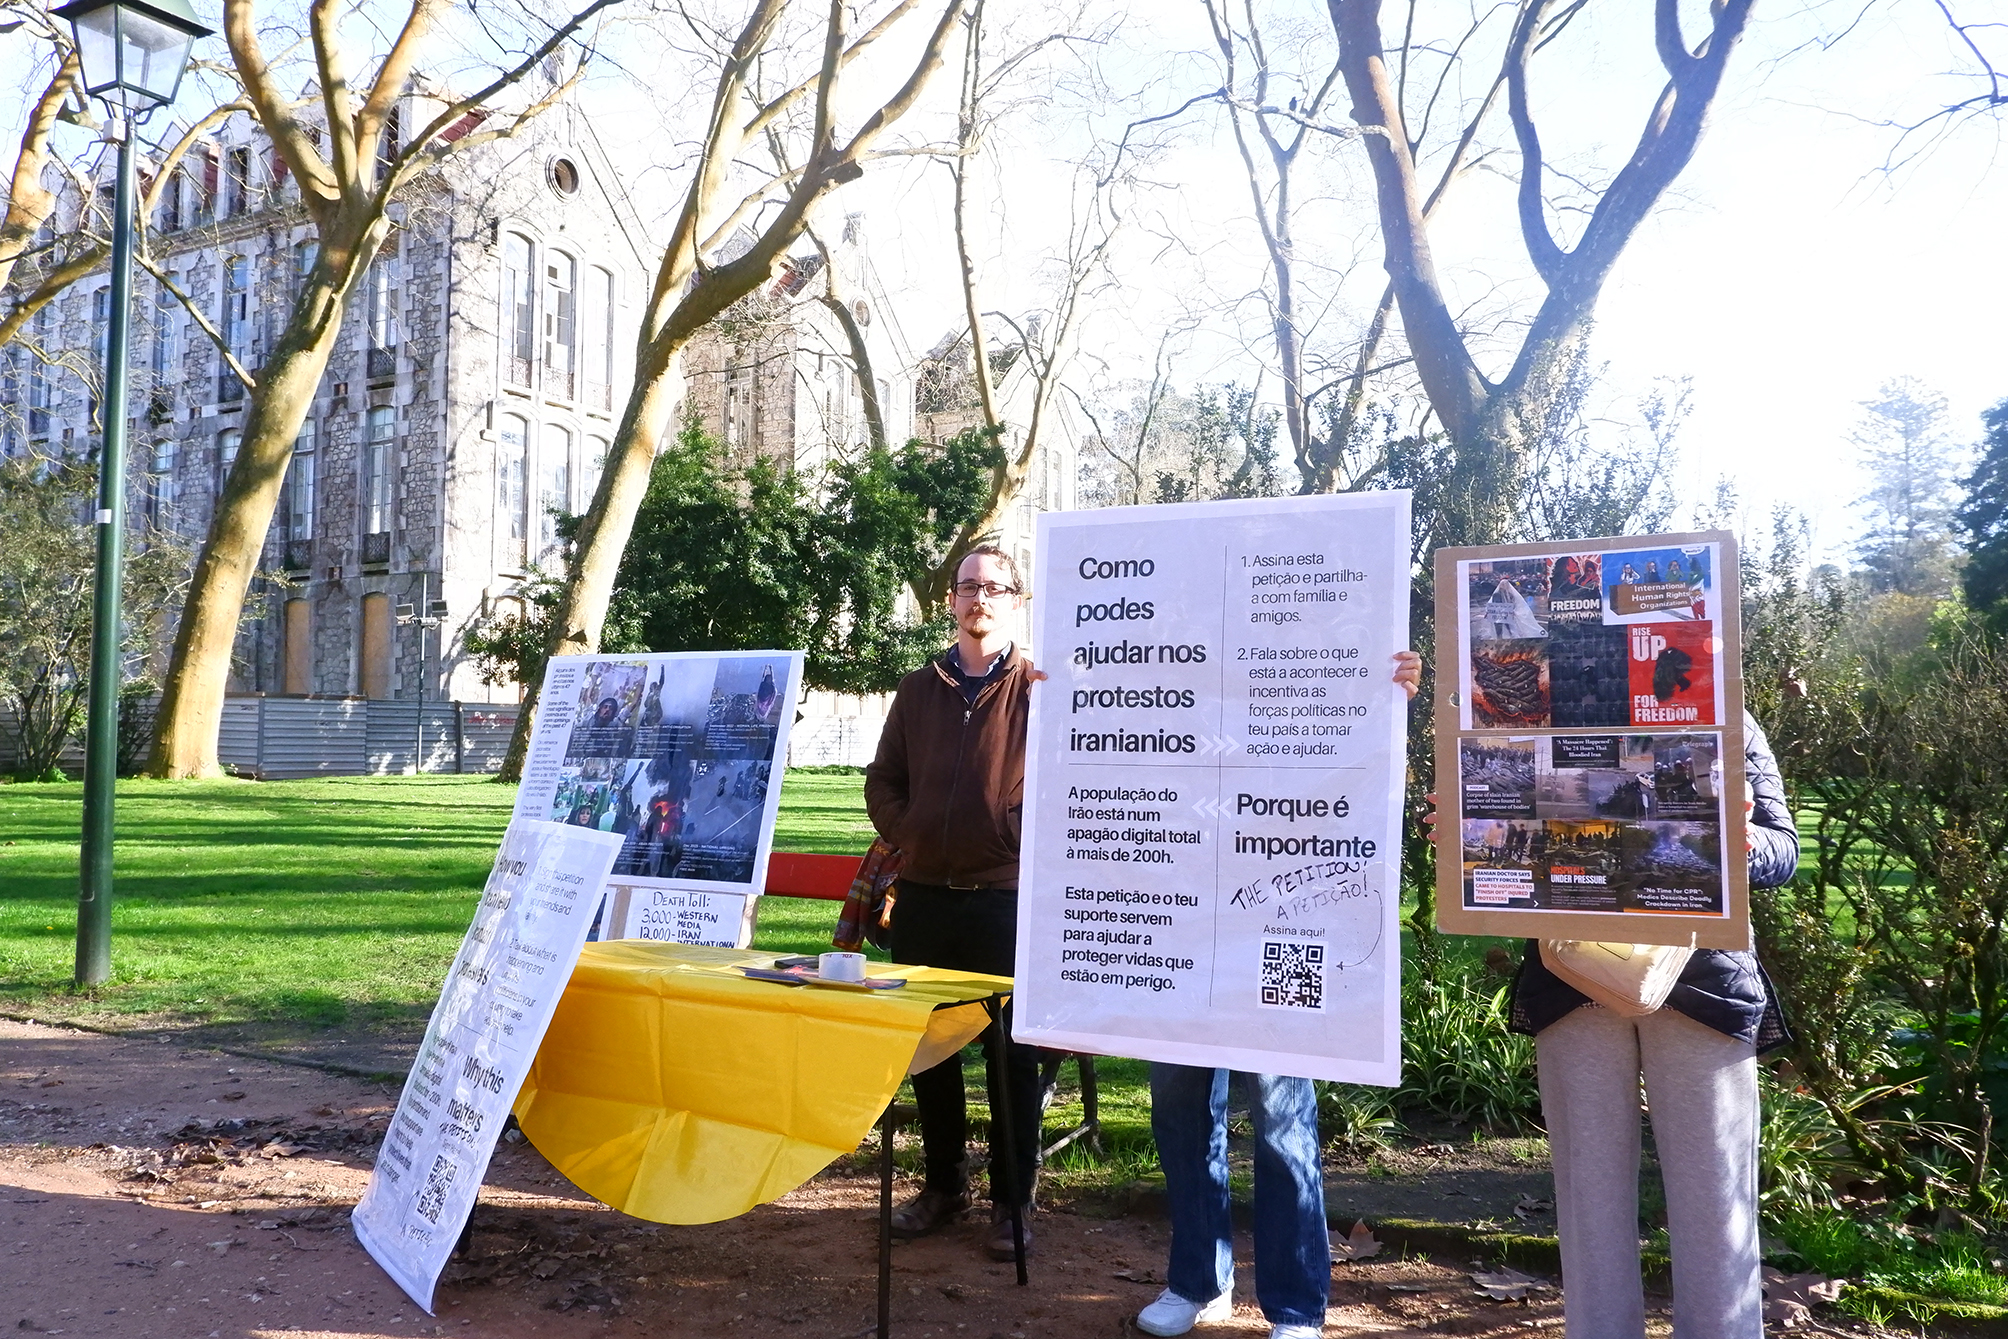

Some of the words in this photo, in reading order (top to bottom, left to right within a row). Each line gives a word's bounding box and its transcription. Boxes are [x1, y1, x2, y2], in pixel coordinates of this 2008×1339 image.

[1079, 557, 1155, 580] Como
[1241, 556, 1251, 567] 1.
[1253, 554, 1294, 567] Assina
[1297, 553, 1324, 565] esta
[1252, 572, 1300, 588] petição
[1303, 574, 1311, 583] e
[1314, 569, 1367, 586] partilha-
[1634, 582, 1686, 593] International
[1251, 594, 1259, 604] a
[1261, 593, 1290, 604] com
[1294, 589, 1336, 603] família
[1339, 591, 1347, 601] e
[1551, 599, 1600, 611] FREEDOM
[1631, 593, 1663, 602] Human
[1665, 591, 1689, 602] Rights
[1640, 599, 1688, 610] Organizations
[1076, 597, 1154, 627] podes
[1251, 610, 1301, 625] amigos.
[1632, 627, 1651, 636] RISE
[1074, 640, 1154, 670] ajudar
[1159, 645, 1206, 663] nos
[1237, 648, 1248, 660] 2.
[1251, 647, 1277, 660] Fala
[1280, 647, 1317, 660] sobre
[1320, 649, 1329, 659] o
[1332, 648, 1358, 662] que
[1632, 635, 1666, 662] UP
[1249, 666, 1276, 679] está
[1279, 669, 1286, 679] a
[1289, 666, 1357, 678] acontecer
[1359, 667, 1368, 677] e
[1072, 686, 1195, 714] protestos
[1249, 685, 1308, 698] incentiva
[1311, 687, 1326, 697] as
[1634, 695, 1659, 708] FOR
[1249, 703, 1288, 720] forças
[1291, 704, 1346, 719] políticas
[1349, 706, 1367, 716] no
[1635, 706, 1698, 723] FREEDOM
[1248, 724, 1269, 735] teu
[1272, 723, 1299, 738] país
[1301, 726, 1309, 736] a
[1312, 724, 1352, 736] tomar
[1071, 728, 1195, 753] iranianios
[1247, 742, 1279, 757] ação
[1282, 745, 1290, 755] e
[1293, 742, 1337, 758] ajudar.
[1068, 786, 1078, 799] A
[1080, 787, 1156, 803] população
[1158, 788, 1177, 802] do
[1069, 806, 1094, 819] Irão
[1096, 808, 1124, 820] está
[1128, 811, 1160, 822] num
[1237, 793, 1329, 822] Porque
[1333, 795, 1349, 818] é
[1067, 828, 1119, 843] apagão
[1121, 828, 1166, 845] digital
[1168, 830, 1201, 844] total
[1235, 831, 1376, 860] importante
[1066, 846, 1074, 859] à
[1077, 847, 1109, 861] mais
[1111, 848, 1130, 862] de
[1132, 849, 1174, 864] 200h.
[1550, 866, 1585, 875] HOSPITALS
[1551, 874, 1572, 883] UNDER
[1574, 875, 1607, 884] PRESSURE
[1229, 879, 1268, 911] THE
[1271, 860, 1369, 897] PETITION!
[653, 891, 685, 907] DEATH
[687, 892, 711, 908] Toll:
[1066, 886, 1094, 900] Esta
[1097, 889, 1150, 906] petição
[1152, 894, 1161, 904] e
[1163, 895, 1172, 905] o
[1174, 893, 1198, 906] teu
[1277, 903, 1289, 920] A
[1289, 872, 1368, 915] PETIÇÃO!
[677, 920, 702, 930] MEDIA
[1064, 909, 1118, 923] suporte
[1120, 913, 1172, 926] servem
[1063, 929, 1094, 942] para
[1097, 929, 1142, 946] ajudar
[1144, 935, 1152, 945] a
[1263, 924, 1297, 935] Assina
[1300, 928, 1325, 939] aqui!
[1062, 949, 1123, 966] proteger
[1125, 952, 1163, 967] vidas
[1165, 957, 1194, 972] que
[1061, 969, 1099, 983] estão
[1101, 973, 1123, 985] em
[1125, 974, 1175, 992] perigo.
[463, 1055, 485, 1090] Why
[482, 1066, 505, 1095] this
[446, 1098, 484, 1133] matters
